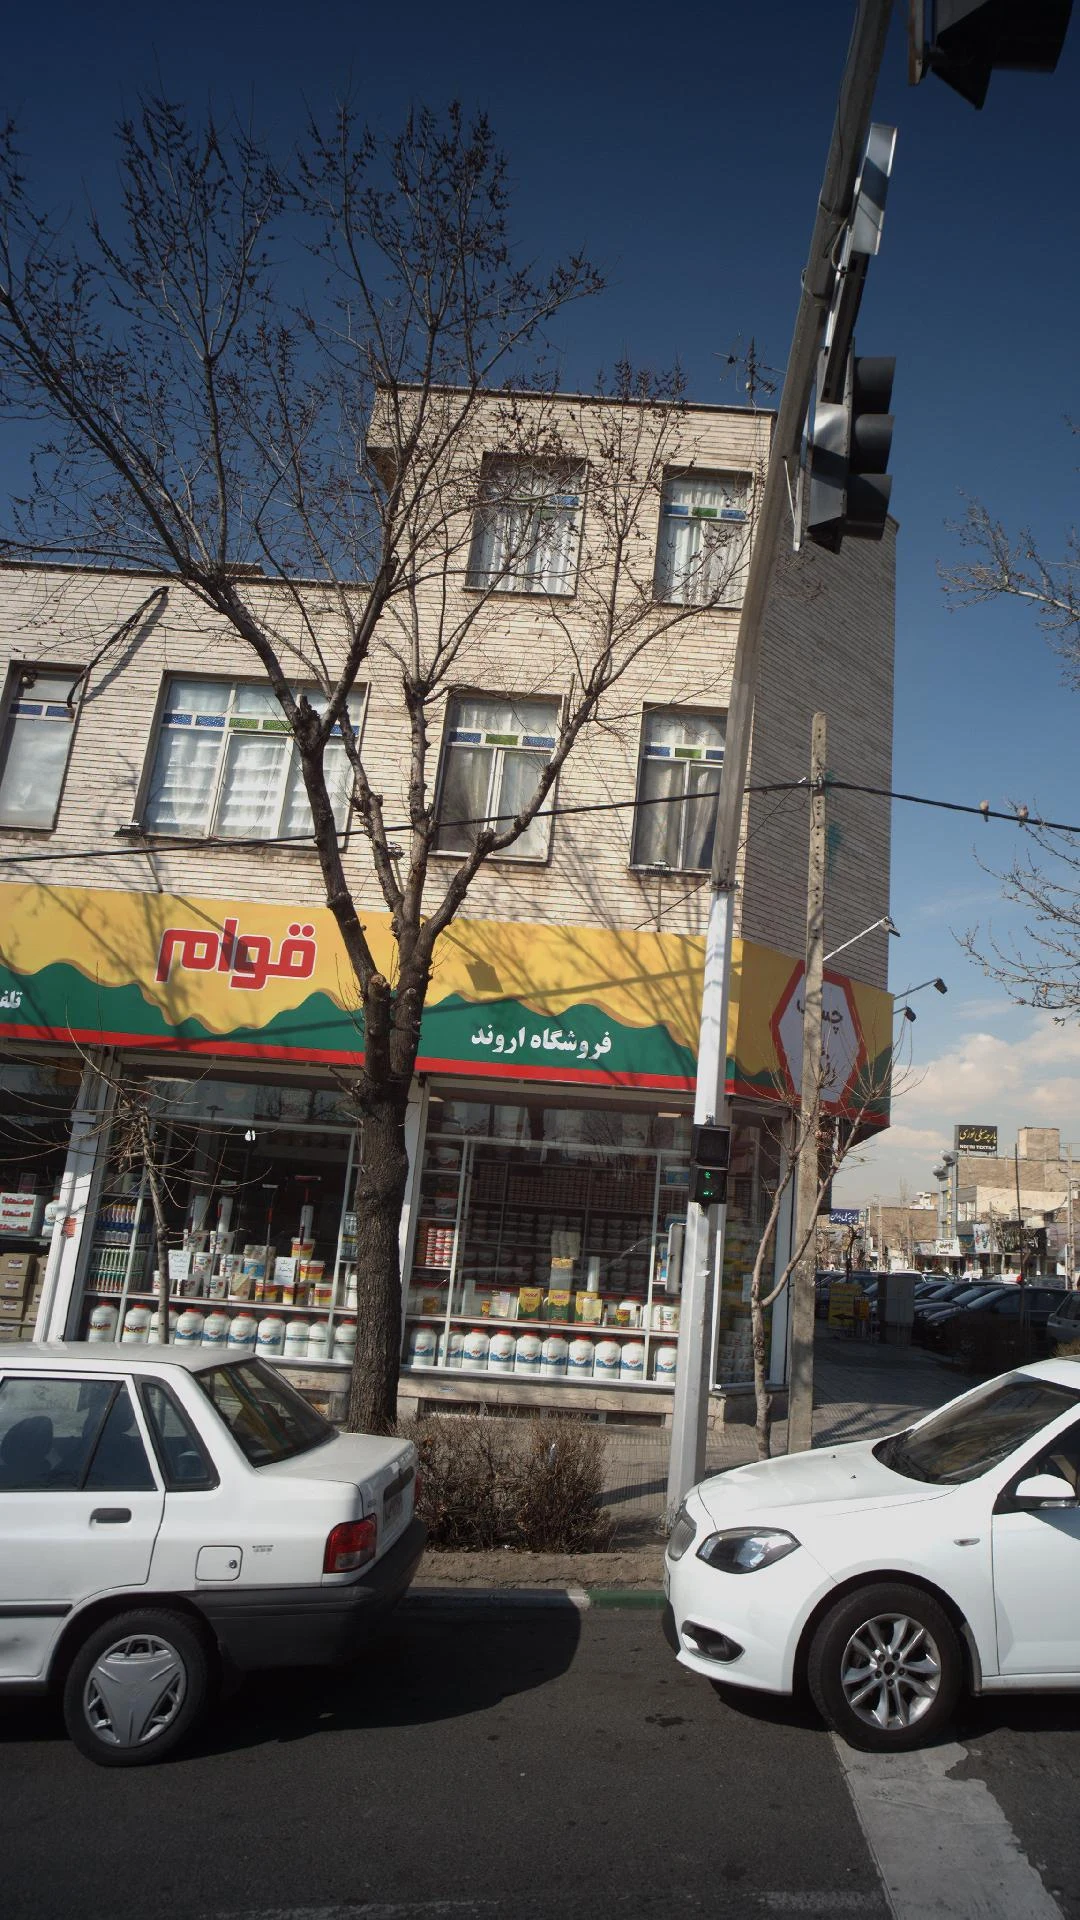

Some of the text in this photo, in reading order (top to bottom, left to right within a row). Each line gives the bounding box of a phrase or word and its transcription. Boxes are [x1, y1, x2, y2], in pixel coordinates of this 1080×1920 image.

[155, 917, 317, 991] قوام
[0, 990, 23, 1009] تلف
[471, 1024, 612, 1060] فروشگاه اروند
